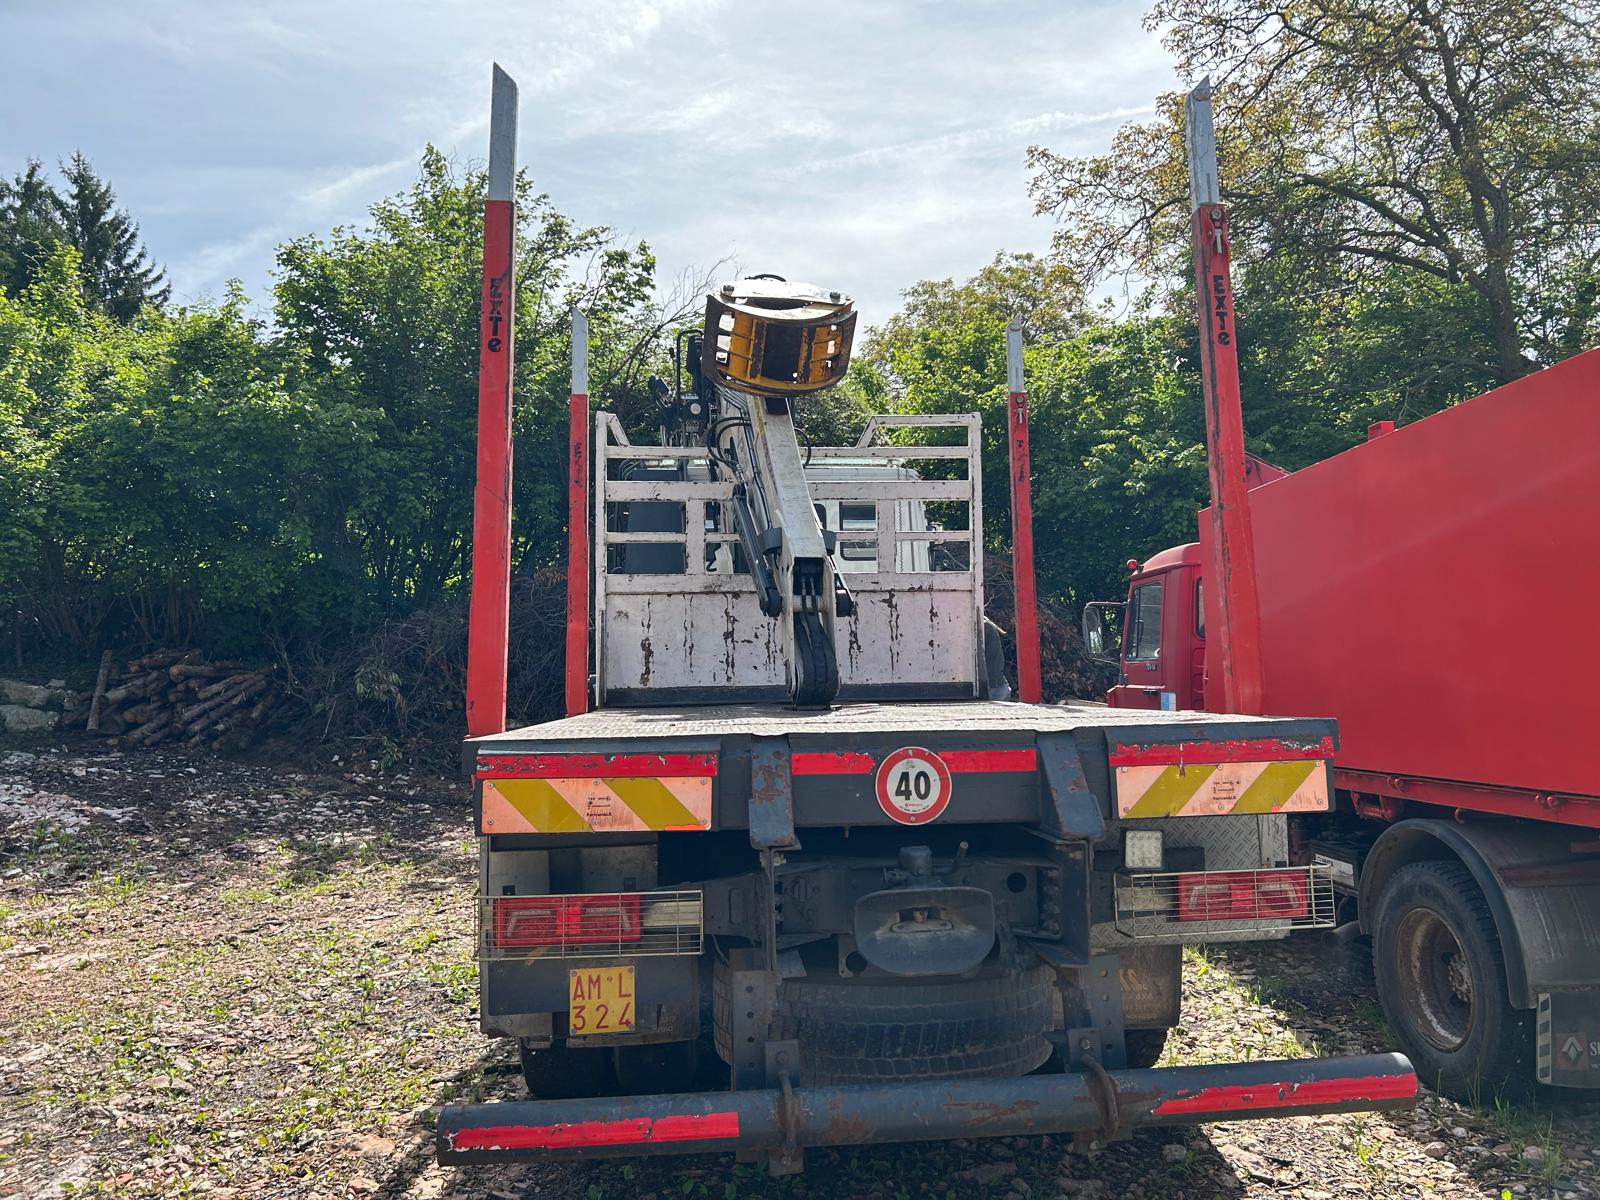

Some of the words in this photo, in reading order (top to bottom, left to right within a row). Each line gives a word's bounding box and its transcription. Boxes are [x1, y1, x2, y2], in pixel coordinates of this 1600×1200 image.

[894, 770, 931, 801] 40
[572, 974, 602, 1001] AM
[572, 1001, 632, 1031] 324
